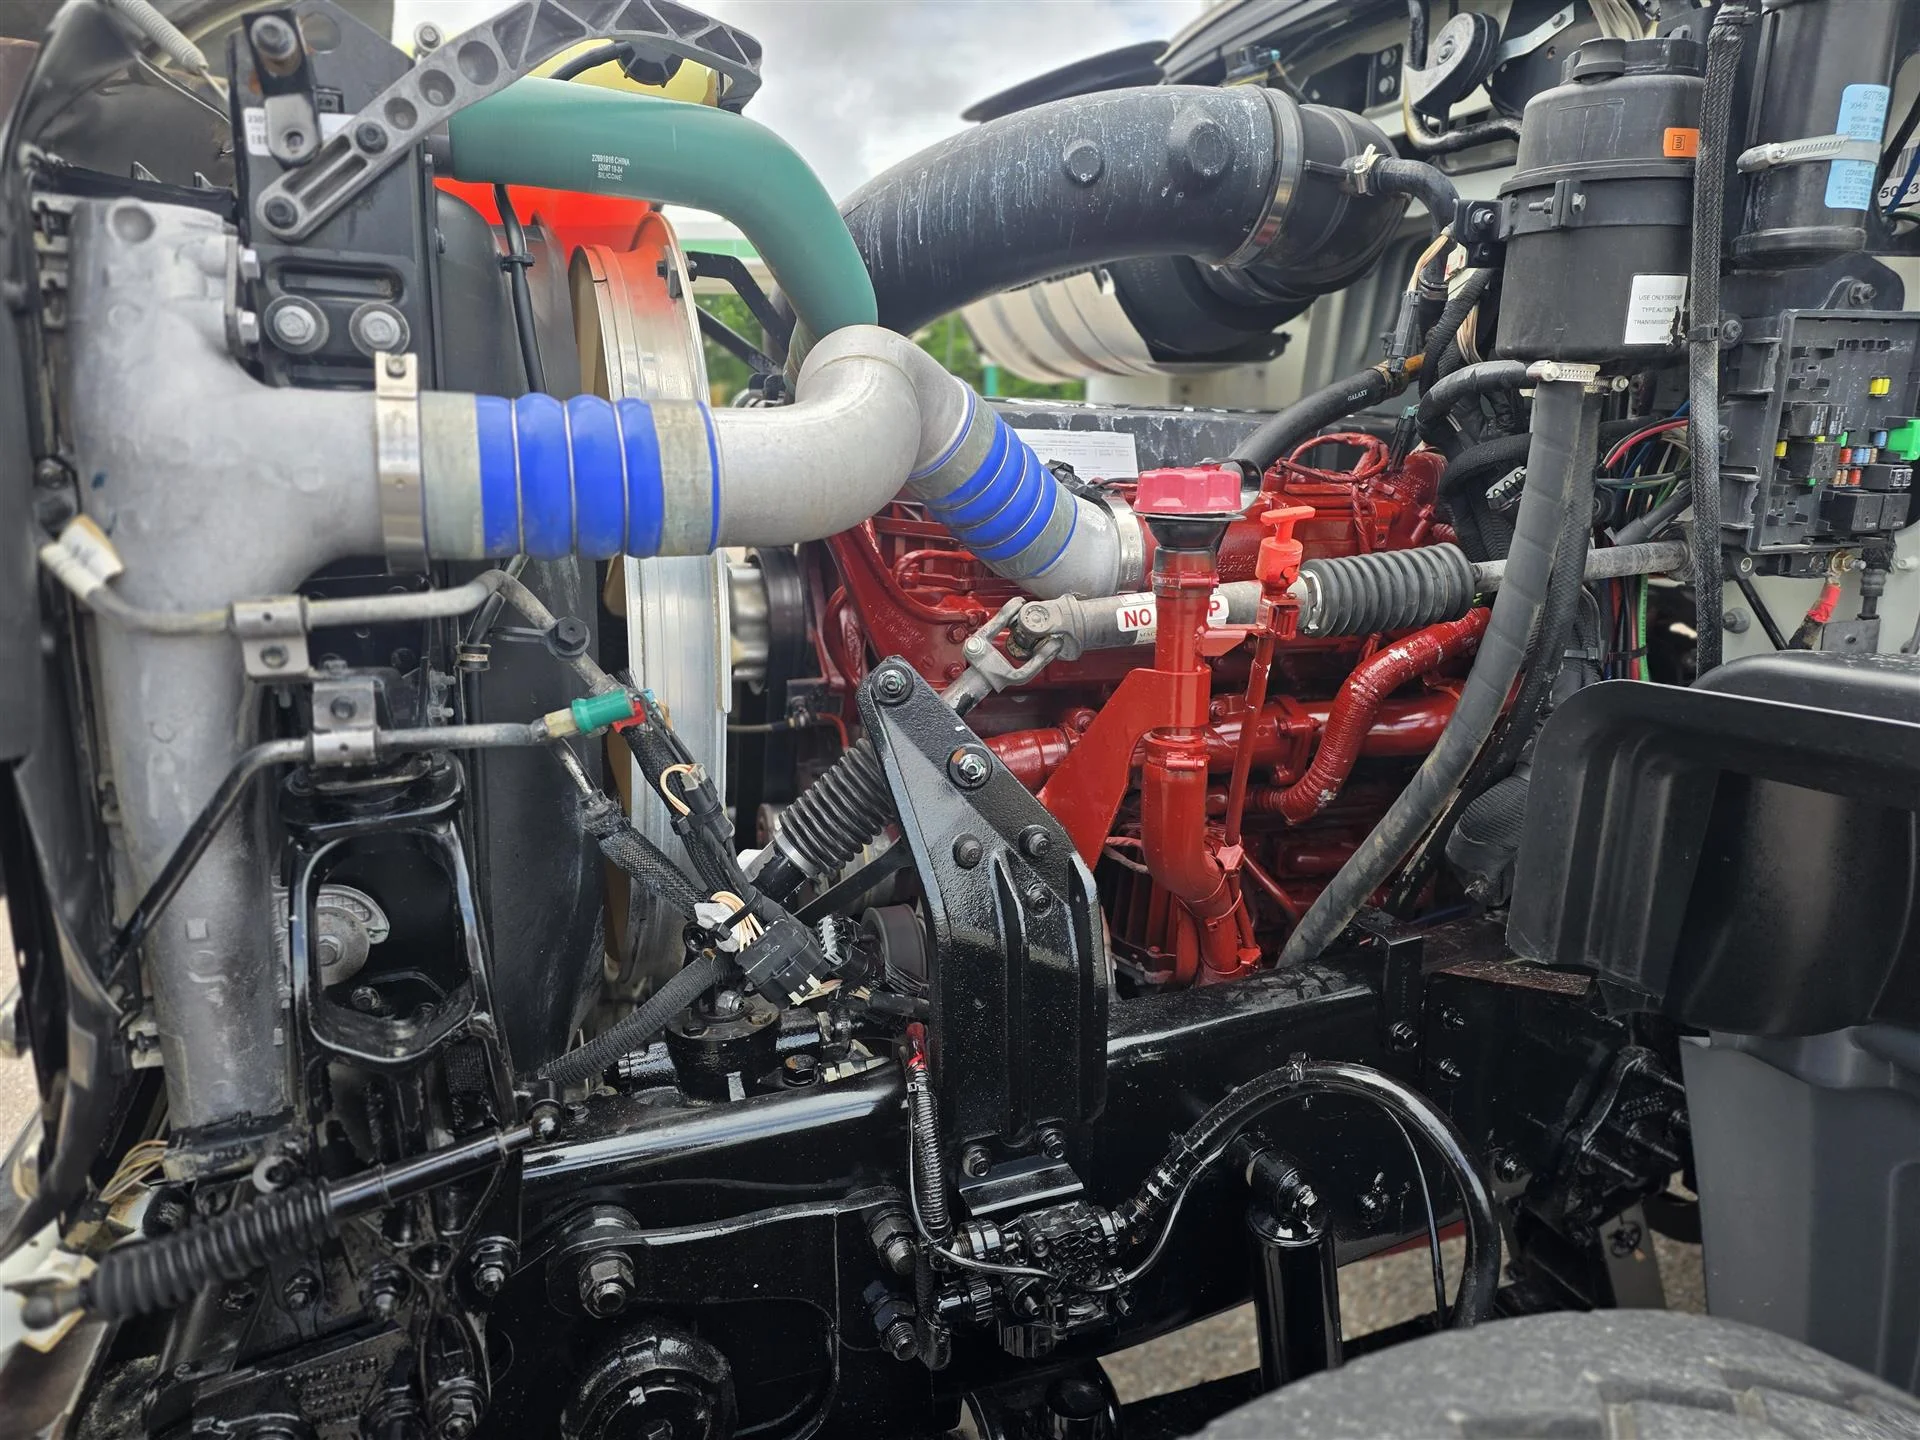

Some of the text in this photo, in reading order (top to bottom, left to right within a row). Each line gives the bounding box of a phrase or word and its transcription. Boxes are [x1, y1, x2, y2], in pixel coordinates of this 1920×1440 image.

[614, 156, 631, 166] CHINA
[598, 171, 623, 181] SILICONE
[1123, 608, 1152, 628] NO
